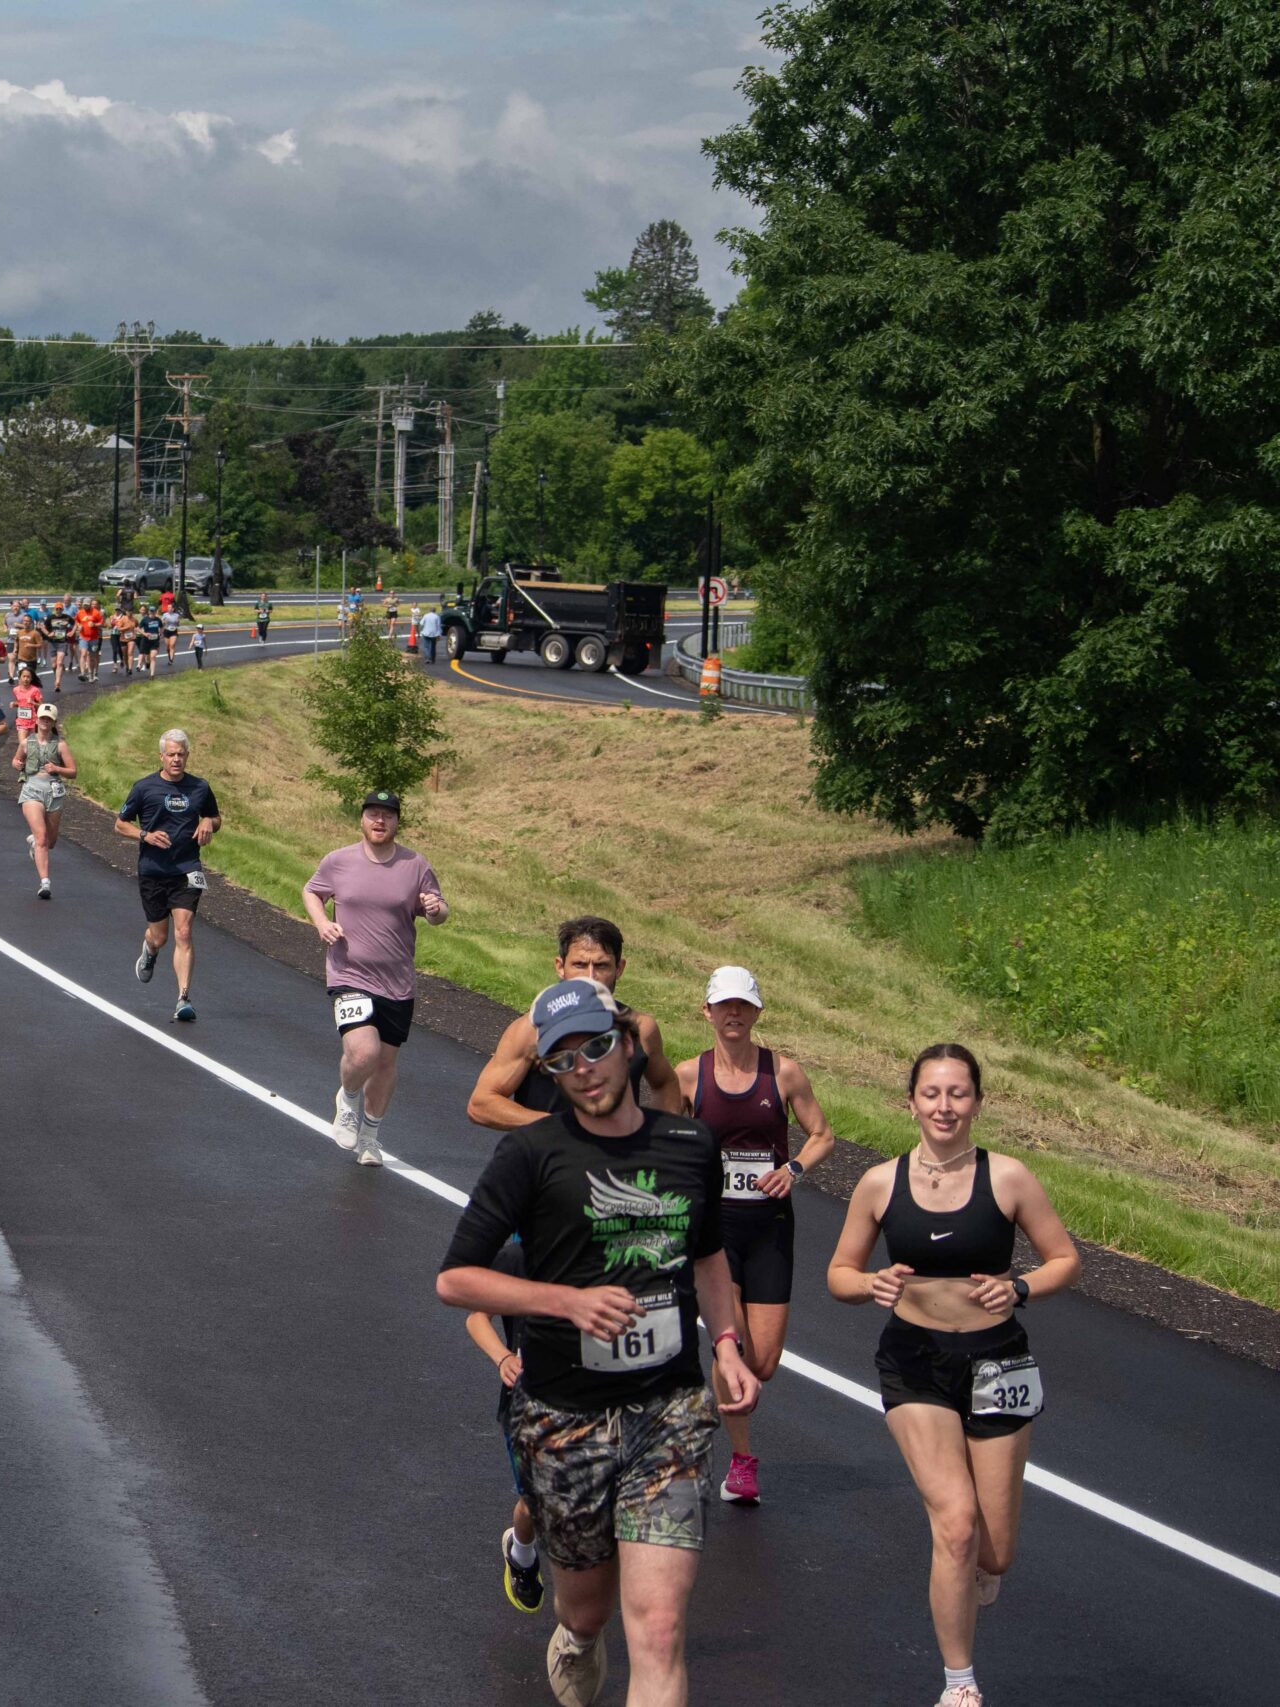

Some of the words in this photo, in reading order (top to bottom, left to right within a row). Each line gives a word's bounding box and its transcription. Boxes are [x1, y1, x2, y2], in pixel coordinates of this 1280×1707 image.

[340, 1005, 363, 1020] 324
[634, 1215, 690, 1231] MOONEY
[657, 1293, 673, 1301] MILE
[611, 1328, 656, 1360] 161
[993, 1384, 1031, 1409] 332
